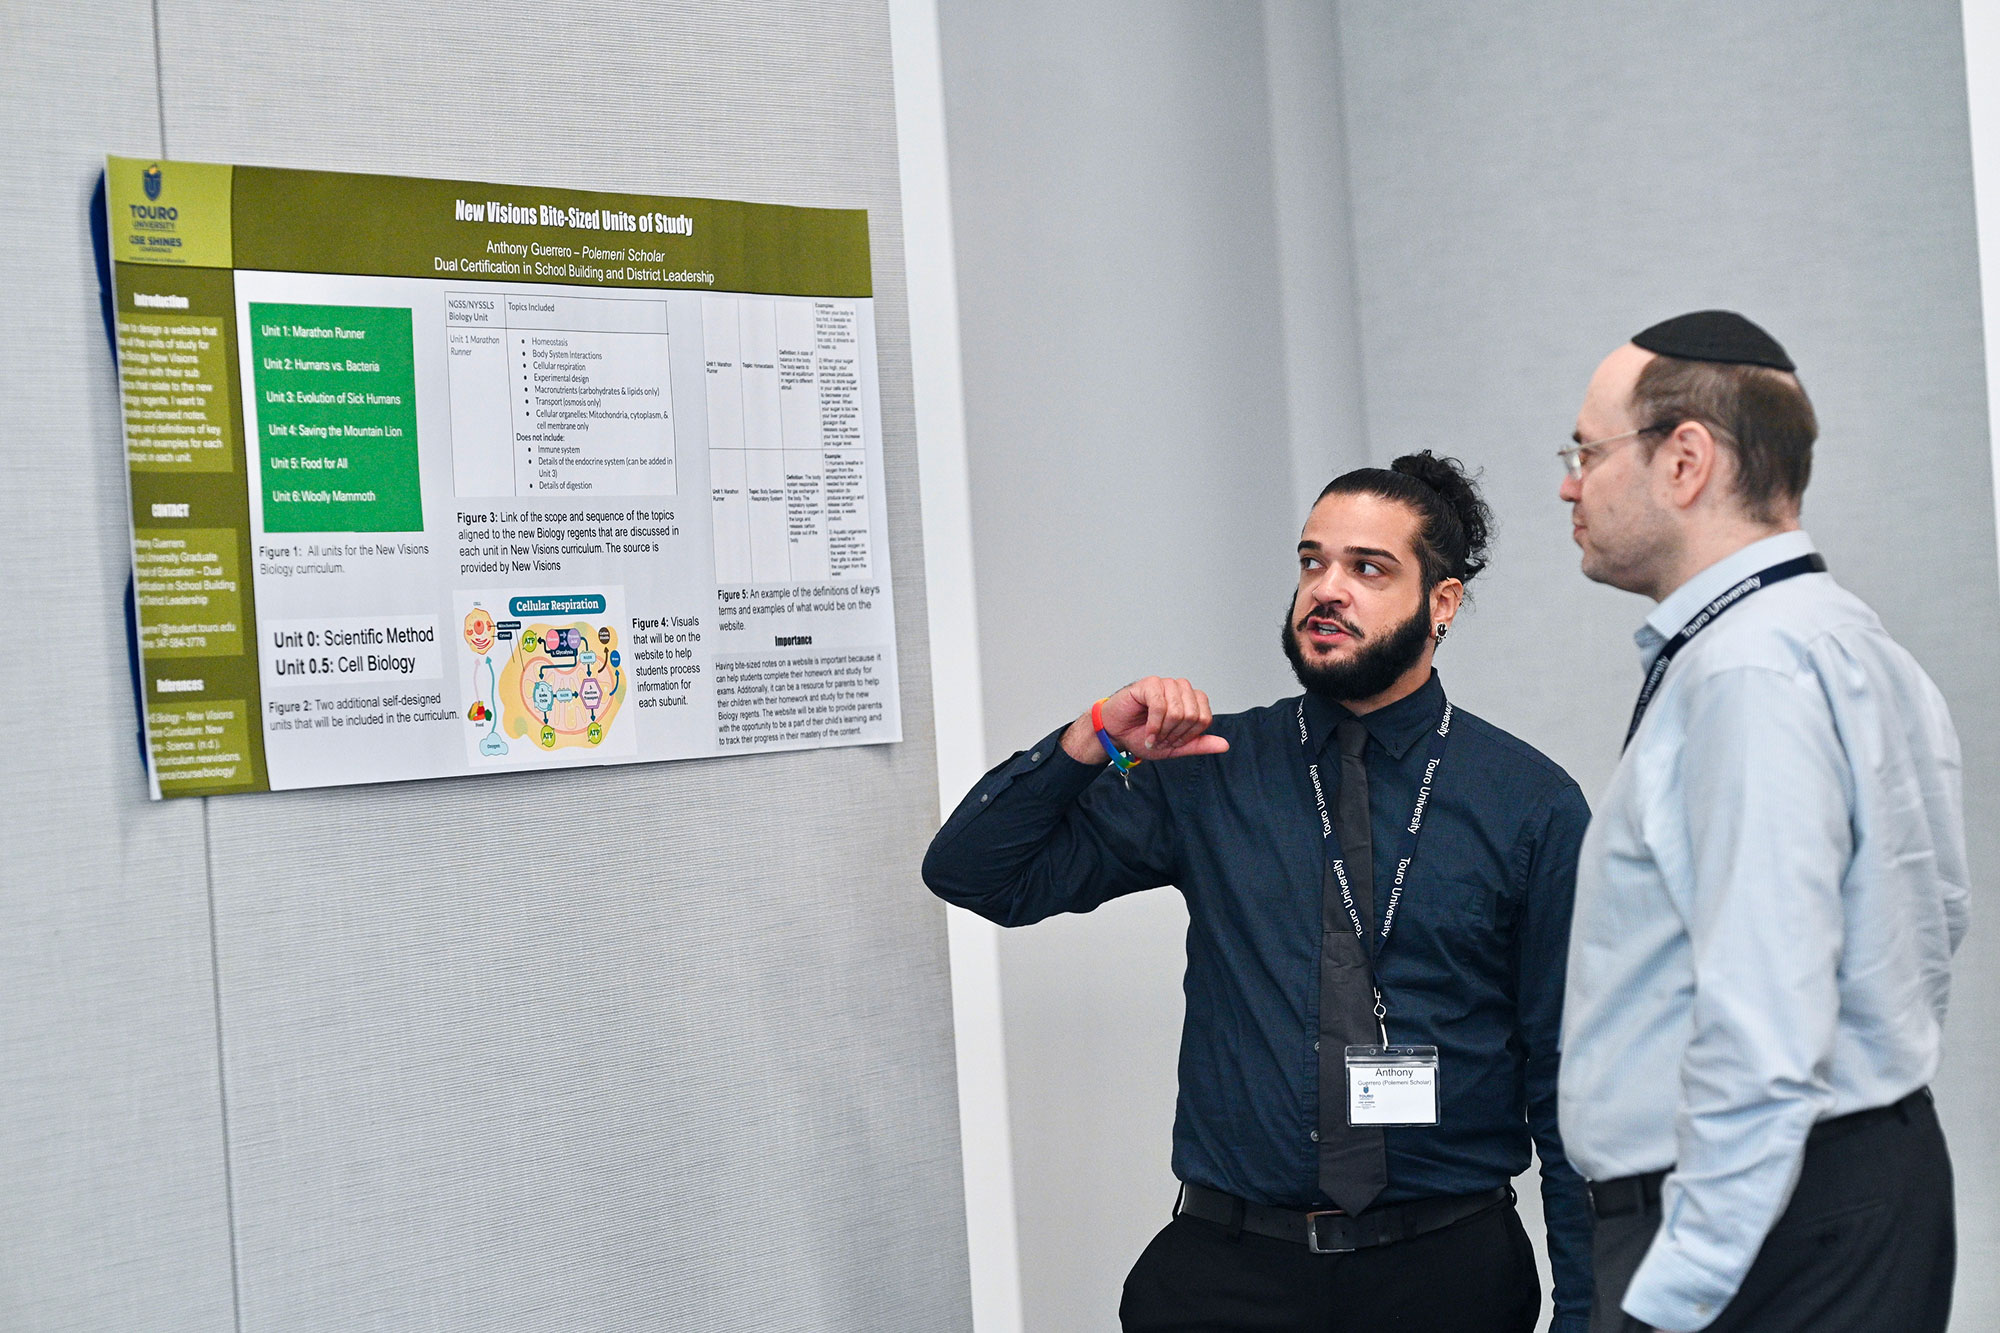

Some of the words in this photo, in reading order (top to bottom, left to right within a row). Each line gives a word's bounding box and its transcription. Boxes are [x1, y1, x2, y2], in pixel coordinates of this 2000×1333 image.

[130, 205, 178, 220] TOURO
[455, 199, 484, 221] New
[487, 201, 537, 224] Visions
[539, 205, 599, 229] Bite-Sized
[601, 210, 636, 231] Units
[638, 212, 652, 232] of
[654, 212, 692, 236] Study
[486, 240, 528, 258] Anthony
[530, 242, 571, 257] Guerrero
[582, 245, 625, 260] Polemeni
[627, 248, 665, 262] Scholar
[434, 256, 458, 271] Dual
[460, 258, 520, 274] Certification
[522, 261, 532, 274] in
[534, 261, 566, 276] School
[568, 264, 603, 280] Building
[605, 267, 624, 279] and
[626, 267, 661, 281] District
[662, 269, 714, 285] Leadership
[448, 300, 494, 309] NGSS/NYSSLS
[508, 302, 527, 312] Topics
[528, 303, 554, 312] Included
[448, 312, 472, 322] Biology
[473, 313, 488, 321] Unit
[261, 324, 281, 337] Unit
[282, 325, 291, 337] 1:
[292, 325, 333, 338] Marathon
[334, 326, 365, 339] Runner
[531, 337, 568, 346] Homeostasis
[263, 357, 283, 370] Unit
[283, 358, 293, 370] 2:
[294, 358, 330, 371] Humans
[330, 362, 344, 371] vs.
[346, 359, 380, 372] Bacteria
[532, 361, 556, 370] Cellular
[556, 362, 586, 371] respiration
[533, 373, 571, 382] Experimental
[571, 374, 589, 384] design
[266, 390, 285, 403] Unit
[285, 391, 296, 403] 3:
[296, 391, 335, 403] Evolution
[336, 392, 346, 404] of
[346, 392, 365, 404] Sick
[366, 392, 401, 404] Humans
[534, 385, 578, 394] Macronutrients
[578, 386, 620, 396] (carbohydrates
[620, 386, 626, 395] &
[626, 386, 643, 396] lipids
[643, 387, 659, 396] only)
[268, 423, 288, 436] Unit
[288, 424, 298, 436] 4:
[298, 424, 327, 438] Saving
[327, 424, 342, 436] the
[343, 424, 383, 436] Mountain
[384, 425, 402, 437] Lion
[270, 457, 289, 469] Unit
[290, 457, 299, 469] 5:
[300, 456, 322, 469] Food
[323, 457, 336, 469] for
[336, 457, 348, 468] All
[272, 490, 291, 502] Unit
[291, 490, 300, 502] 6:
[300, 490, 331, 503] Woolly
[332, 490, 376, 501] Mammoth
[457, 512, 487, 525] Figure
[489, 511, 498, 522] 3:
[500, 511, 518, 522] Link
[519, 510, 528, 522] of
[530, 511, 542, 522] the
[544, 513, 567, 524] scope
[569, 511, 584, 522] and
[585, 512, 624, 523] sequence
[626, 509, 634, 521] of
[636, 510, 649, 520] the
[651, 509, 674, 522] topics
[259, 545, 290, 560] Figure
[292, 545, 302, 556] 1:
[307, 545, 319, 556] All
[321, 546, 342, 556] units
[344, 544, 357, 556] for
[359, 544, 373, 555] the
[375, 544, 395, 555] New
[396, 543, 429, 554] Visions
[260, 563, 293, 577] Biology
[296, 562, 344, 574] curriculum.
[460, 561, 497, 574] provided
[499, 561, 509, 574] by
[511, 560, 531, 571] New
[532, 559, 561, 571] Visions
[717, 589, 740, 602] Figure
[741, 588, 748, 599] 5:
[749, 588, 759, 598] An
[760, 588, 790, 599] example
[792, 586, 799, 597] of
[800, 587, 811, 597] the
[812, 586, 849, 596] definitions
[850, 584, 858, 595] of
[859, 585, 880, 596] keys
[516, 599, 549, 611] Cellular
[550, 598, 598, 612] Respiration
[1681, 612, 1710, 638] Touro
[1706, 576, 1761, 616] University
[632, 617, 659, 630] Figure
[660, 616, 668, 627] 4:
[670, 616, 699, 626] Visuals
[718, 620, 744, 631] website.
[274, 631, 303, 648] Unit
[306, 630, 320, 647] 0:
[324, 628, 383, 646] Scientific
[386, 626, 434, 643] Method
[525, 636, 535, 644] ATP
[774, 635, 812, 646] Importance
[634, 649, 664, 660] website
[665, 648, 673, 659] to
[674, 647, 692, 660] help
[275, 659, 305, 675] Unit
[308, 657, 333, 674] 0.5:
[338, 656, 363, 672] Cell
[367, 655, 415, 673] Biology
[268, 701, 300, 715] Figure
[302, 699, 312, 711] 2:
[314, 698, 334, 710] Two
[336, 696, 380, 709] additional
[382, 693, 440, 707] self-designed
[638, 696, 657, 708] each
[658, 695, 688, 706] subunit.
[543, 732, 553, 741] ATP
[589, 729, 600, 737] ATP
[1298, 716, 1308, 745] Touro
[1422, 758, 1440, 784] Touro
[1309, 764, 1327, 810] University
[1407, 786, 1431, 835] University
[1318, 809, 1332, 838] Touro
[1394, 857, 1411, 885] Touro
[1333, 859, 1353, 909] University
[1380, 886, 1403, 938] University
[1348, 908, 1364, 939] Touro
[1375, 1068, 1414, 1078] Anthony
